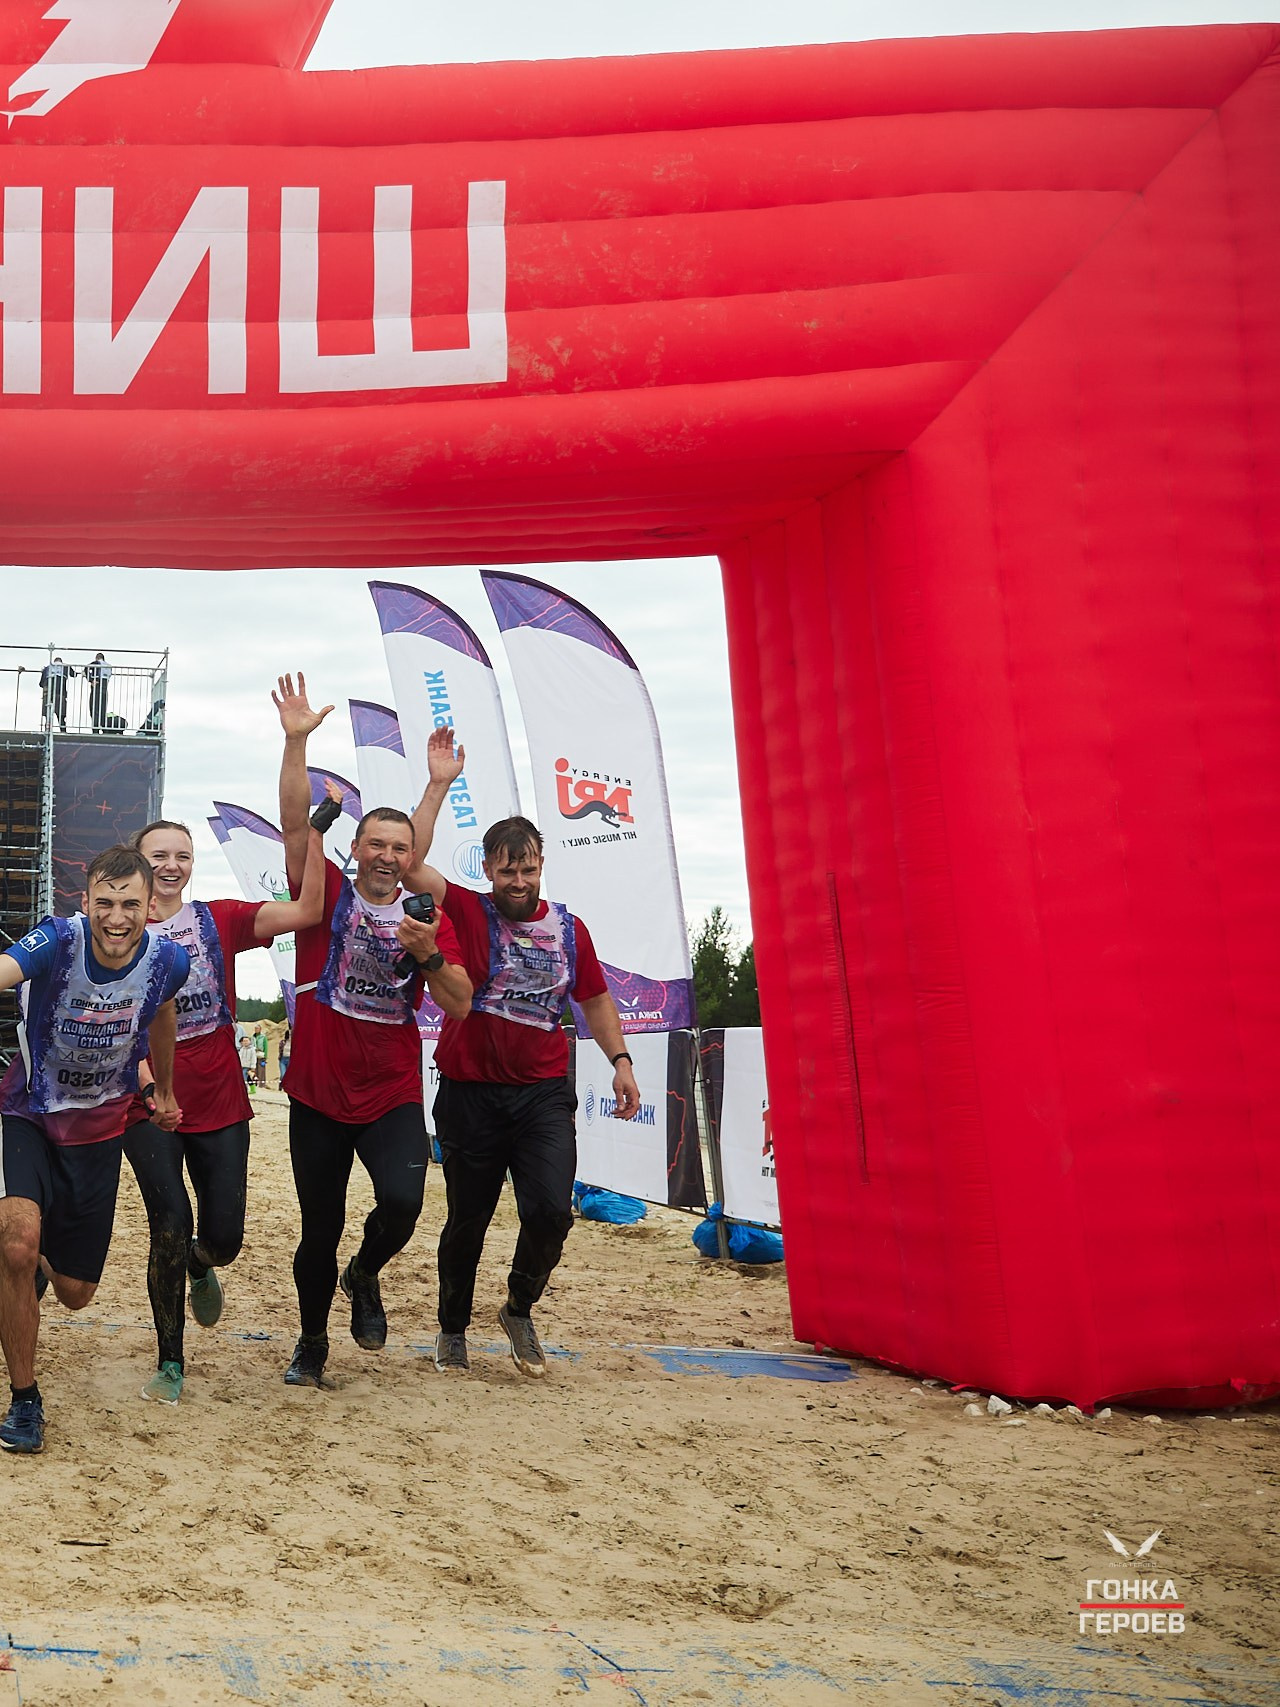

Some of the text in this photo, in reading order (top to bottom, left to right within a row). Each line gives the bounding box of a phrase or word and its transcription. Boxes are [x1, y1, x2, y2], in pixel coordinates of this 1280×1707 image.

[71, 998, 100, 1010] ГОНКА
[63, 1021, 131, 1036] КОМАНДНЫЙ
[80, 1036, 111, 1048] СТАРТ
[58, 1068, 117, 1087] 03207
